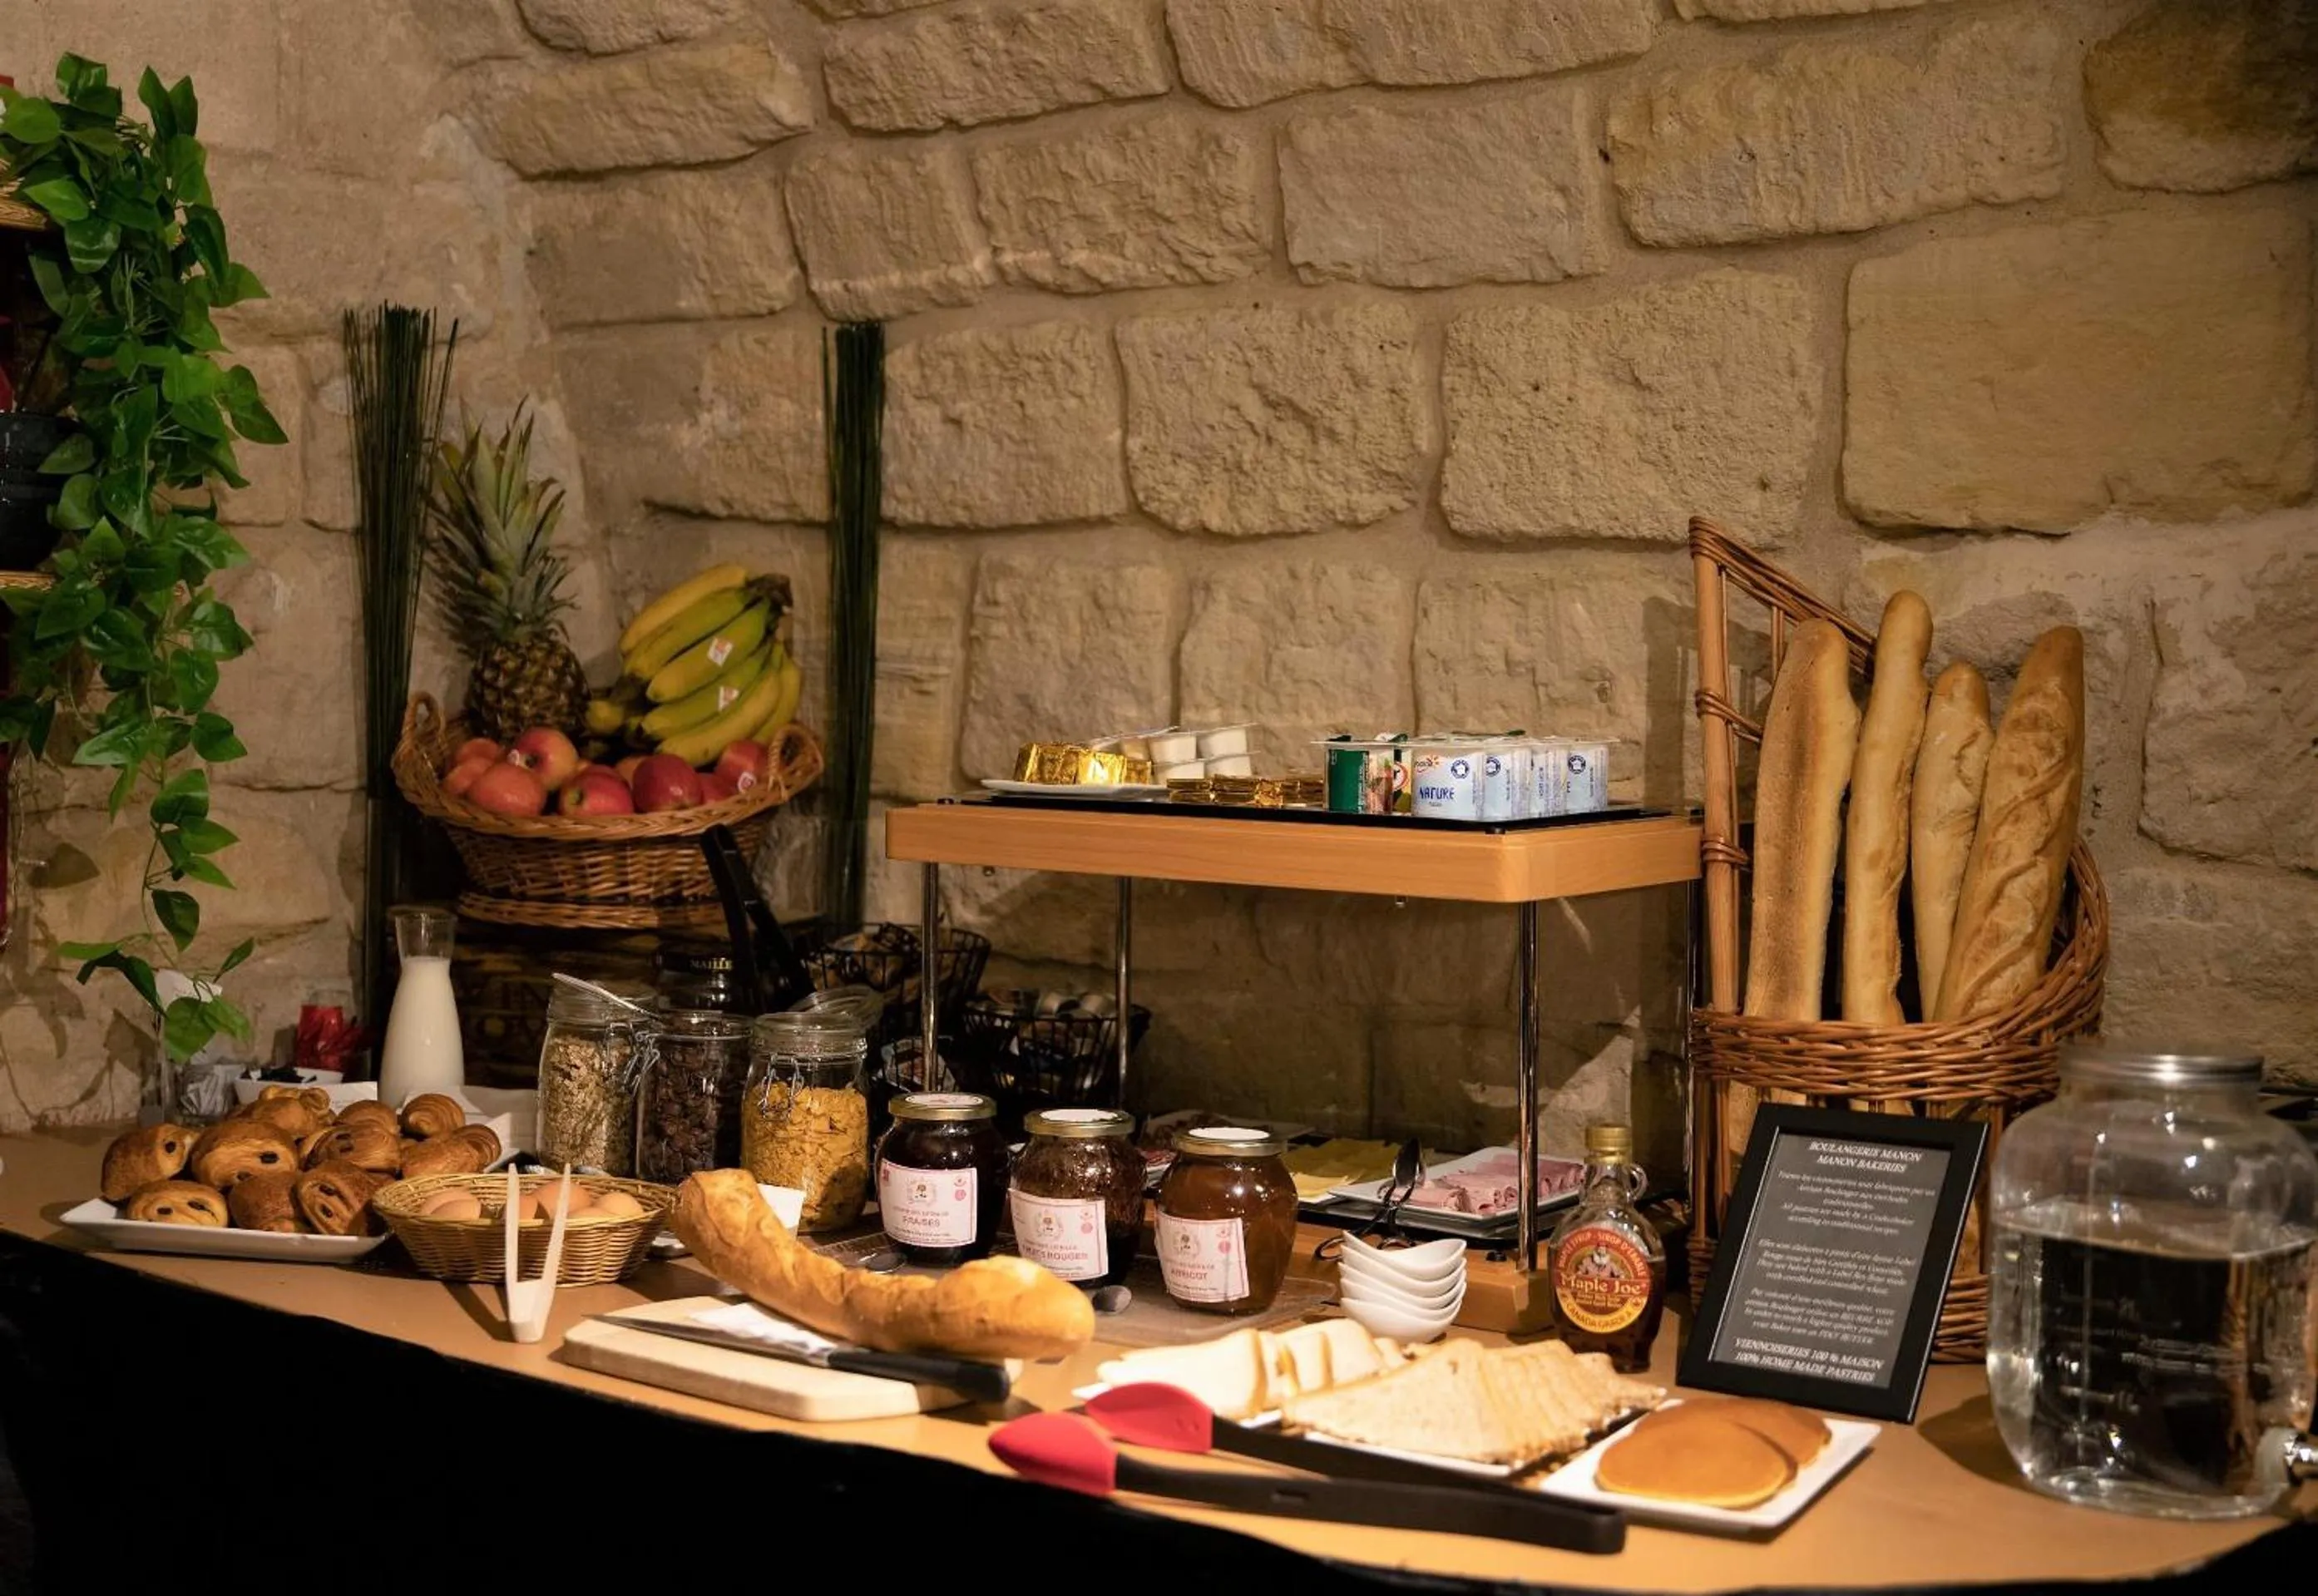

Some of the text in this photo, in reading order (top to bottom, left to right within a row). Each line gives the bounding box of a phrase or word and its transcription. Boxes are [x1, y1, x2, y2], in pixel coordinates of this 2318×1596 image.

[1420, 787, 1455, 799] NATURE
[1816, 1154, 1857, 1167] MANON
[1880, 1149, 1923, 1162] MANON
[1560, 1272, 1642, 1295] Maple Joe
[1759, 1356, 1795, 1370] HOME
[1792, 1361, 1827, 1375] MADE
[1839, 1354, 1886, 1371] MAISON
